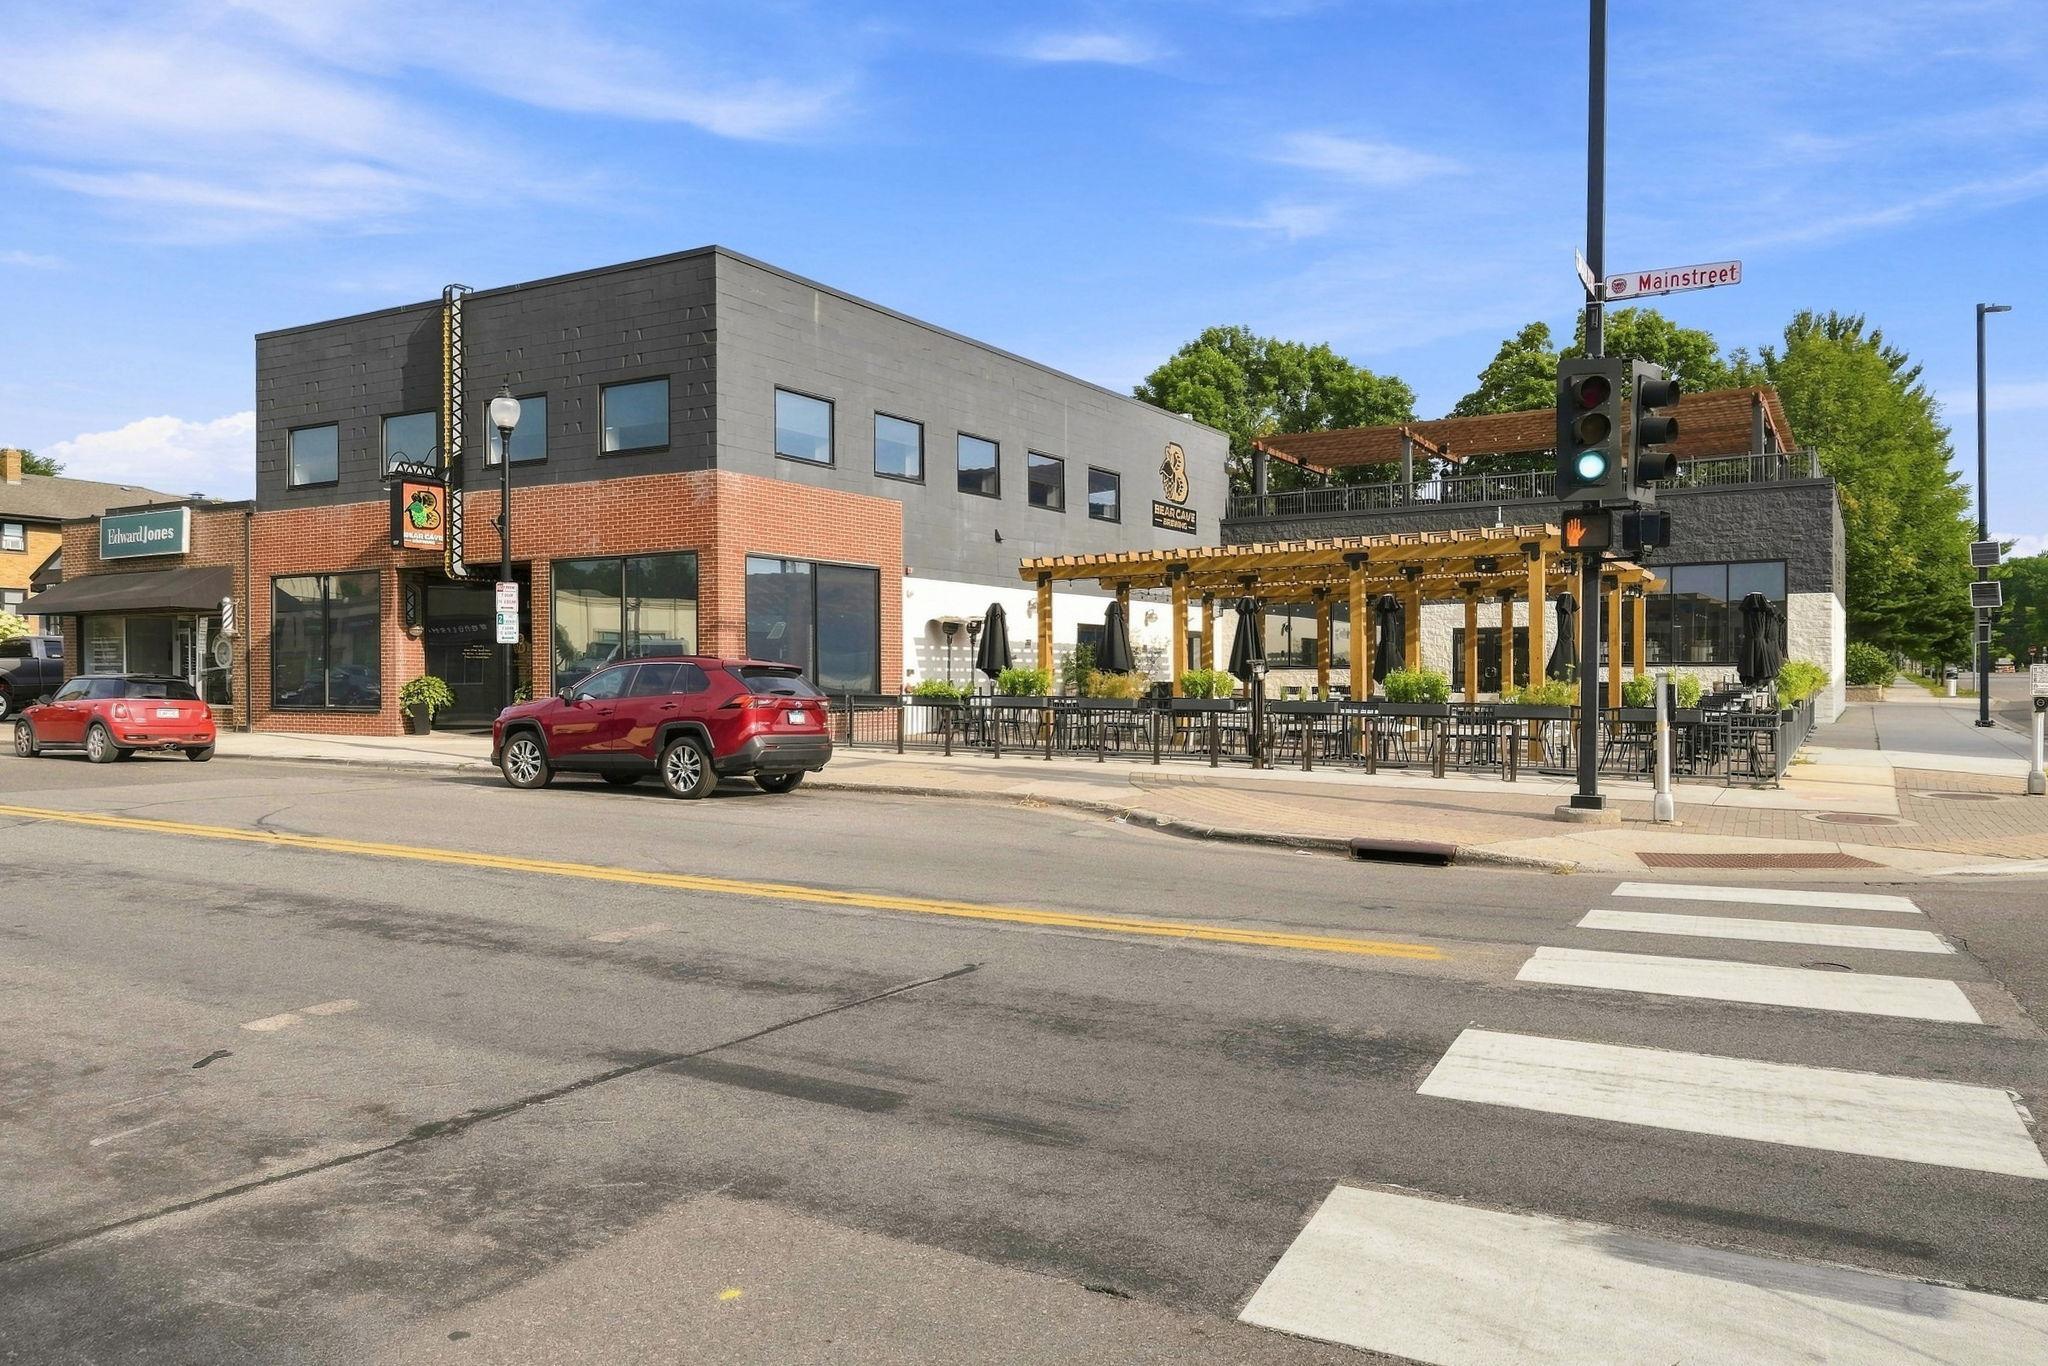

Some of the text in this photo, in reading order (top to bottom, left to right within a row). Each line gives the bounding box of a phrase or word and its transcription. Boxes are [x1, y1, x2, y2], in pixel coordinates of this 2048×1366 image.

[1638, 264, 1738, 292] Mainstreet
[1154, 503, 1196, 523] BEAR CAVE
[1163, 518, 1188, 530] BREWING
